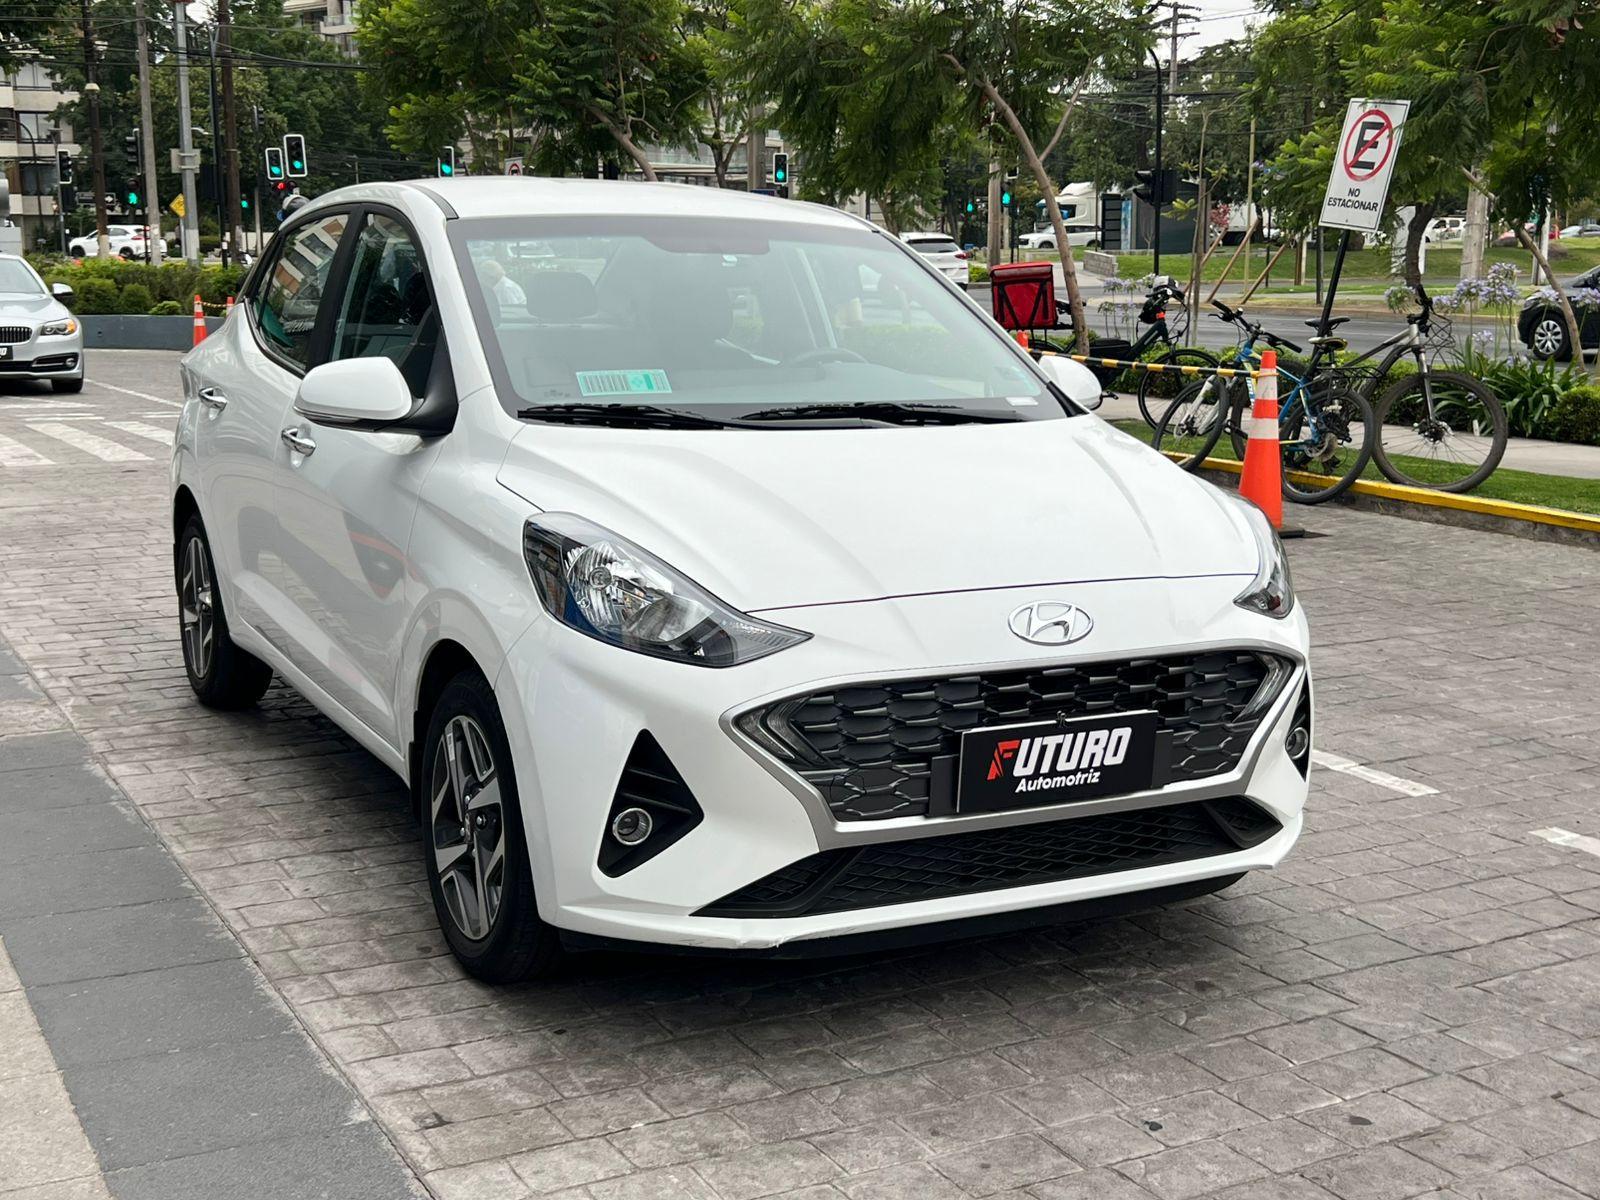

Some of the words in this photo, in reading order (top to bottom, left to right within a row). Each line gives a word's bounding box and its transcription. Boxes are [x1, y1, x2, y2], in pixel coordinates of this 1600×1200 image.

[1347, 187, 1361, 198] NO
[1327, 197, 1379, 212] ESTACIONAR
[986, 727, 1132, 781] FUTURO
[1015, 768, 1101, 793] Automotriz
